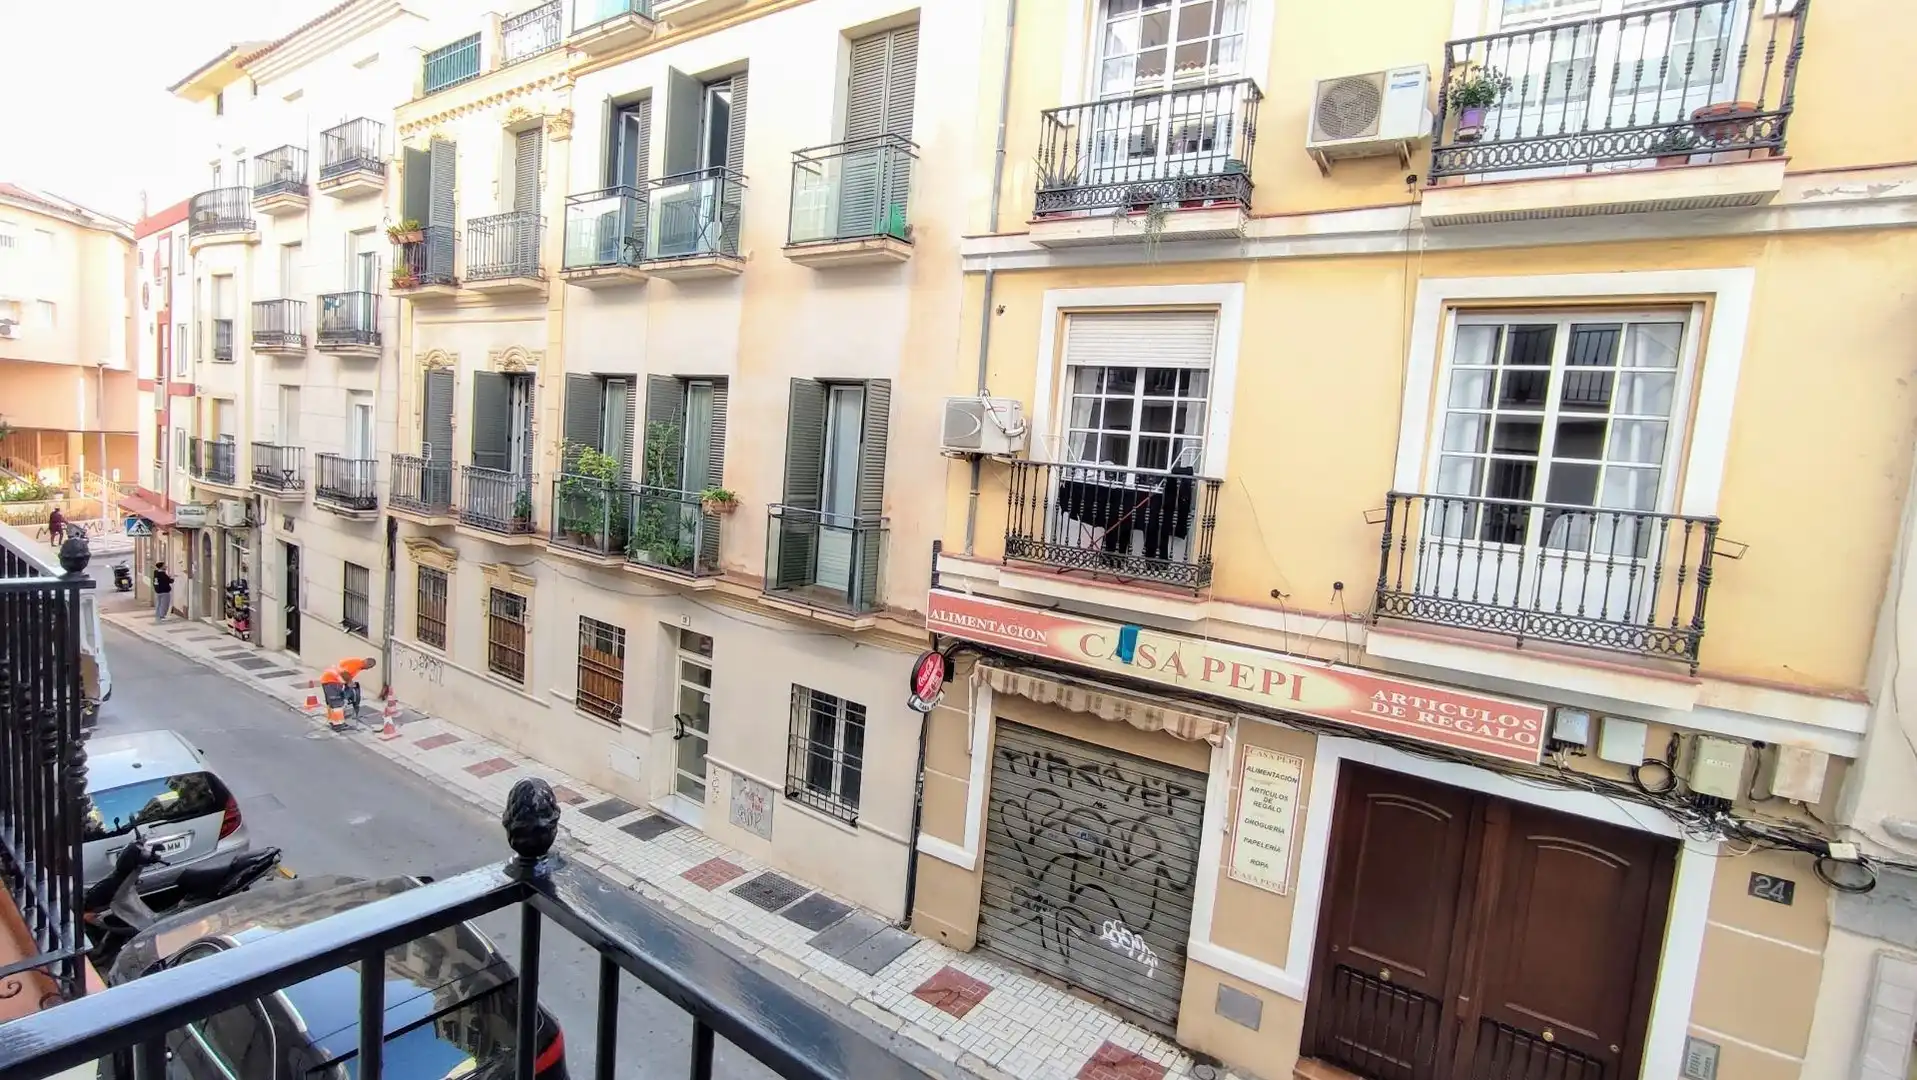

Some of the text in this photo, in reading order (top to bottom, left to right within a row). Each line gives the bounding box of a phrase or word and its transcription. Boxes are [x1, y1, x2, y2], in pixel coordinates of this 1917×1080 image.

[930, 608, 1048, 642] ALIMENTACION
[1079, 633, 1307, 702] CSA PEPI
[1370, 689, 1538, 732] ARTICULOS
[1370, 702, 1406, 719] DE
[1417, 711, 1537, 746] REGALO
[1253, 800, 1282, 814] REGALO
[1249, 858, 1269, 869] ROPA
[1754, 875, 1785, 902] 24
